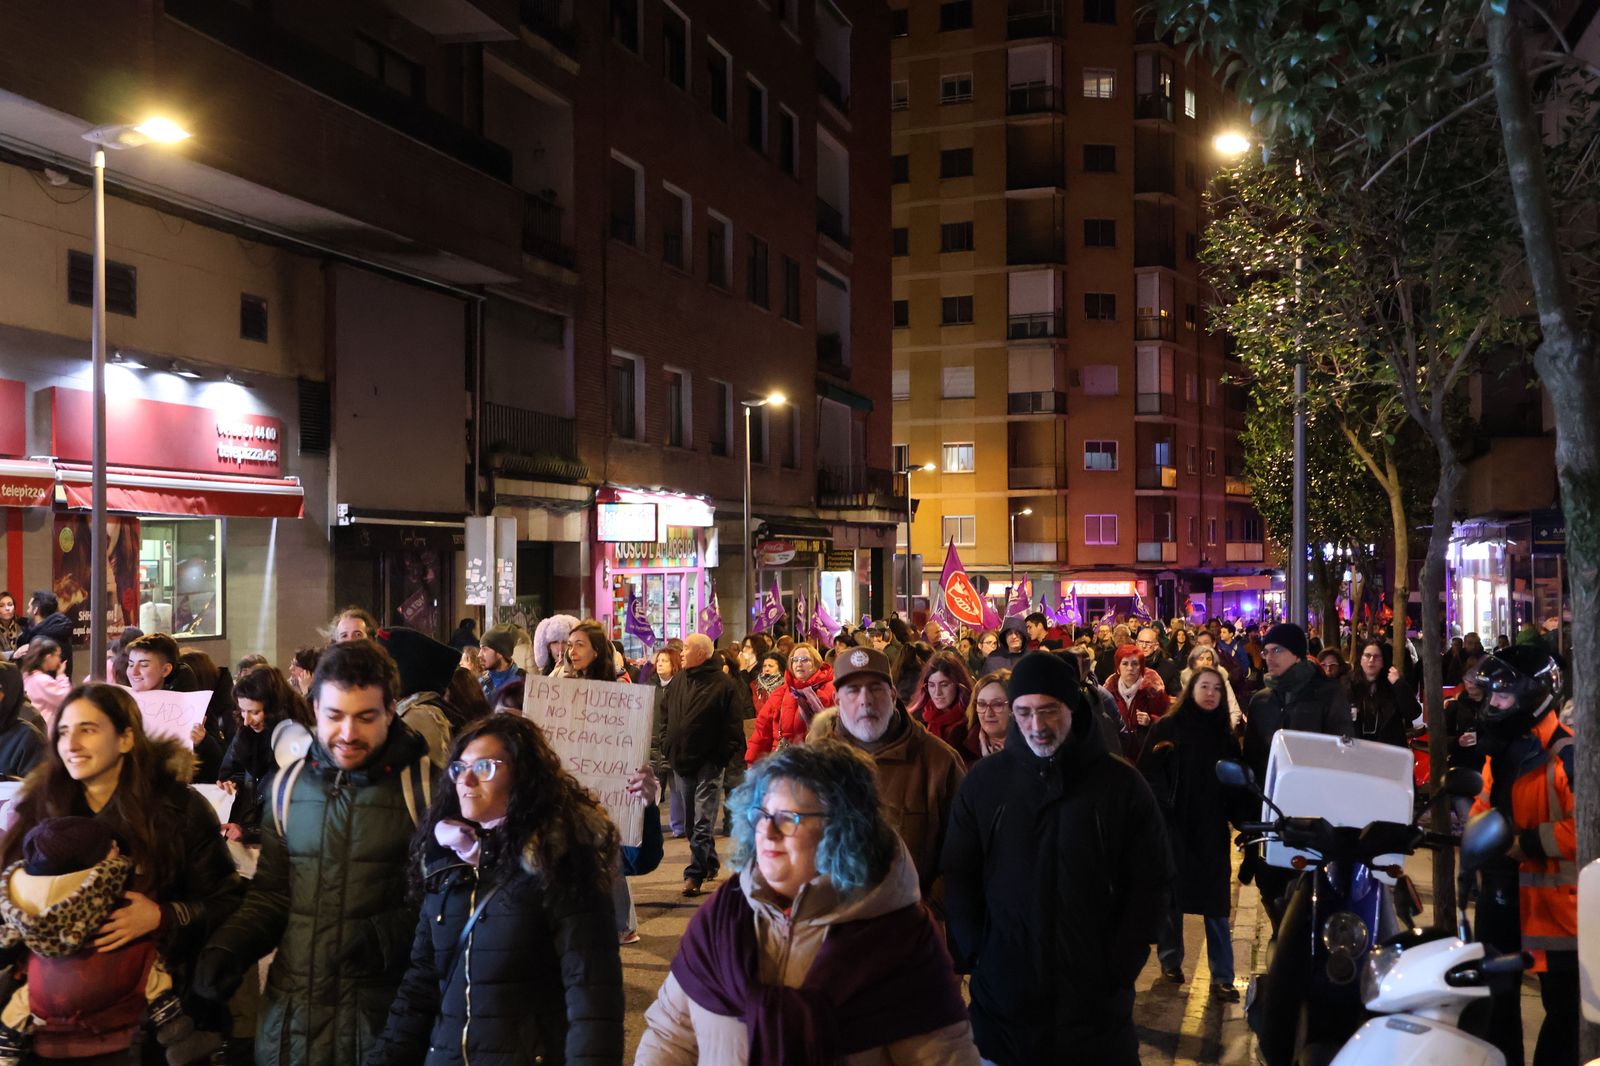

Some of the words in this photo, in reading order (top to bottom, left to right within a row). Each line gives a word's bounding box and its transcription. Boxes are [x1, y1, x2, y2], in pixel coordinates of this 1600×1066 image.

[1, 484, 46, 502] telepizza
[615, 541, 648, 559] KIOSCO
[528, 680, 560, 700] LAS
[571, 685, 643, 709] MUJERES
[545, 705, 567, 718] NO
[574, 710, 625, 726] SOMOS
[542, 724, 633, 748] ERCANCÍA
[568, 757, 634, 776] SEXUAL
